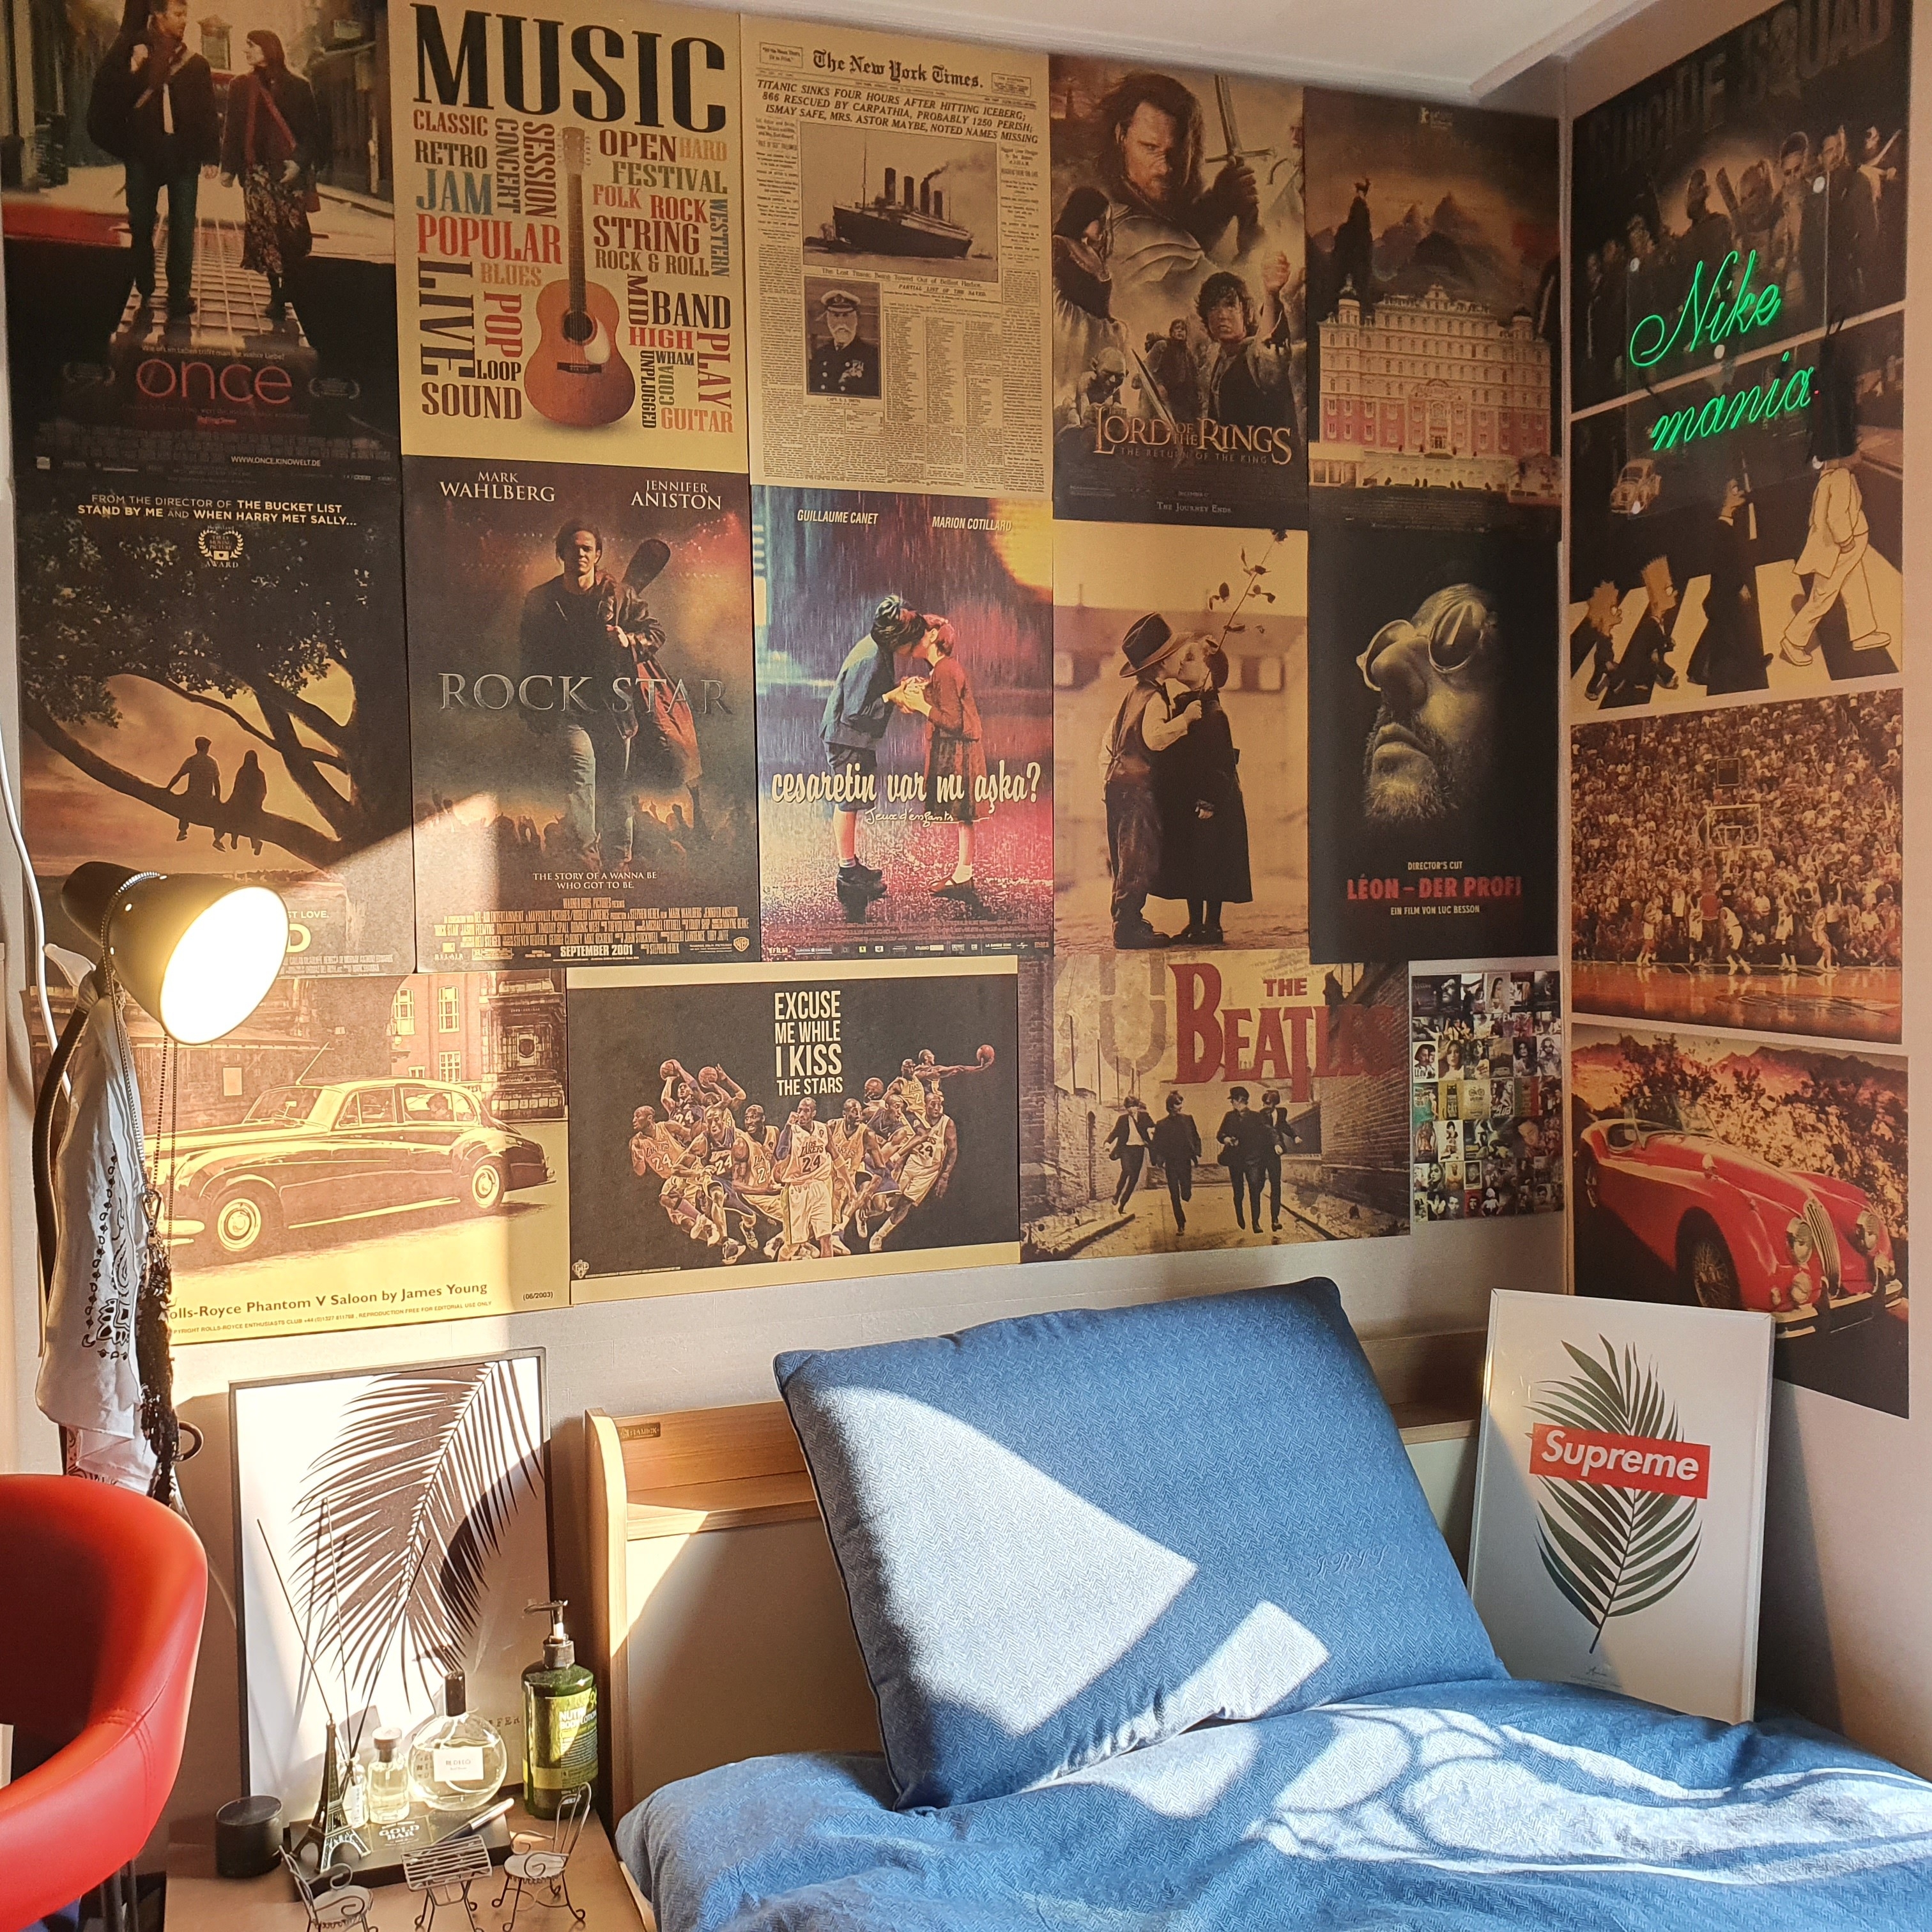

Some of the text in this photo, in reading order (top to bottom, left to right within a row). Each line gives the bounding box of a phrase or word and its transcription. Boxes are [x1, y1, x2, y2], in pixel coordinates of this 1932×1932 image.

[410, 3, 726, 133] MUSIC
[813, 49, 844, 72] The
[849, 56, 884, 75] New
[889, 61, 927, 82] York
[932, 66, 983, 88] Times.
[757, 79, 1025, 121] TITANIC SINKS FOUR HOURS AFTER HITTING ICEBERG;
[762, 92, 779, 102] 866
[783, 95, 830, 108] RESCUED
[834, 100, 848, 110] BY
[852, 102, 912, 119] CARPATHIA,
[917, 109, 969, 125] PROBABLY
[972, 117, 992, 127] 1250
[413, 110, 488, 137] CLASSIC
[766, 104, 1038, 144] ISMAY SAFE, MRS. ASTOR MAYBE, NOTED NAMES MISSING
[415, 139, 487, 169] RETRO
[600, 130, 677, 162] OPEN
[679, 137, 727, 162] HARD
[495, 118, 521, 215] CONCERT
[522, 120, 557, 219] SESSION
[612, 161, 727, 194] FESTIVAL
[416, 168, 493, 216] JAM
[592, 185, 641, 210] FOLK
[650, 195, 708, 224] ROCK
[417, 213, 562, 264] POPULAR
[593, 215, 700, 254] STRING
[710, 199, 729, 277] WESTERN
[480, 263, 542, 287] BLUES
[595, 249, 709, 277] ROCK & ROLL
[627, 275, 648, 325] MID
[651, 290, 730, 329] BAND
[1630, 249, 1782, 367] Nike
[417, 257, 475, 377] LIVE
[482, 292, 523, 358] POP
[629, 326, 694, 349] HIGH
[476, 359, 522, 381] LOOP
[656, 350, 694, 366] WHAM
[696, 332, 732, 408] PLAY
[136, 358, 292, 404] once
[640, 350, 656, 428] UNPLUGGED
[659, 365, 673, 405] CODA
[422, 383, 522, 419] SOUND
[1650, 351, 1815, 452] mania
[661, 408, 733, 433] GUITAR
[1093, 406, 1291, 465] LORD OF THE RINGS
[1121, 448, 1140, 457] THE
[1216, 454, 1235, 462] THE
[1240, 455, 1267, 464] KING
[478, 471, 518, 483] MARK
[646, 480, 708, 493] JENNIFER
[91, 494, 341, 513] FROM THE DIRECTOR OF THE BUCKET LIST
[440, 482, 555, 502] WAHLBERG
[631, 492, 721, 510] ANISTON
[78, 505, 356, 526] STAND BY ME AND WHEN HARRY MET SALLY...
[797, 510, 878, 525] GUILLAUME CANET
[932, 516, 1011, 532] MARION COTILLARD
[438, 672, 732, 715] ROCK STAR
[771, 763, 877, 802] cesaretin
[887, 771, 927, 802] var
[865, 808, 897, 825] Jeux
[1407, 861, 1463, 870] DIRECTOR'S CUT
[1347, 873, 1522, 900] LÉON DER PROFI
[301, 910, 330, 919] LOVE.
[1390, 905, 1480, 915] EIN FILM VON LUC BESSON
[560, 945, 633, 957] SEPTEMBER 2001
[1263, 977, 1308, 997] THE
[774, 991, 840, 1020] EXCUSE
[775, 1020, 841, 1044] ME WHILE
[1168, 963, 1396, 1103] BEATLES
[776, 1044, 842, 1077] I KISS
[777, 1077, 843, 1096] THE STARS
[652, 1153, 672, 1171] 24
[715, 1154, 732, 1175] 24
[802, 1155, 821, 1172] 24
[169, 1284, 487, 1319] olls-Royce Phantom V Saloon by James Young
[523, 1291, 553, 1301] (06/2003)
[359, 1309, 404, 1318] REPRODUCTION
[1542, 1429, 1699, 1481] Supreme
[379, 1825, 420, 1837] GOLD
[388, 1832, 415, 1841] BAR
